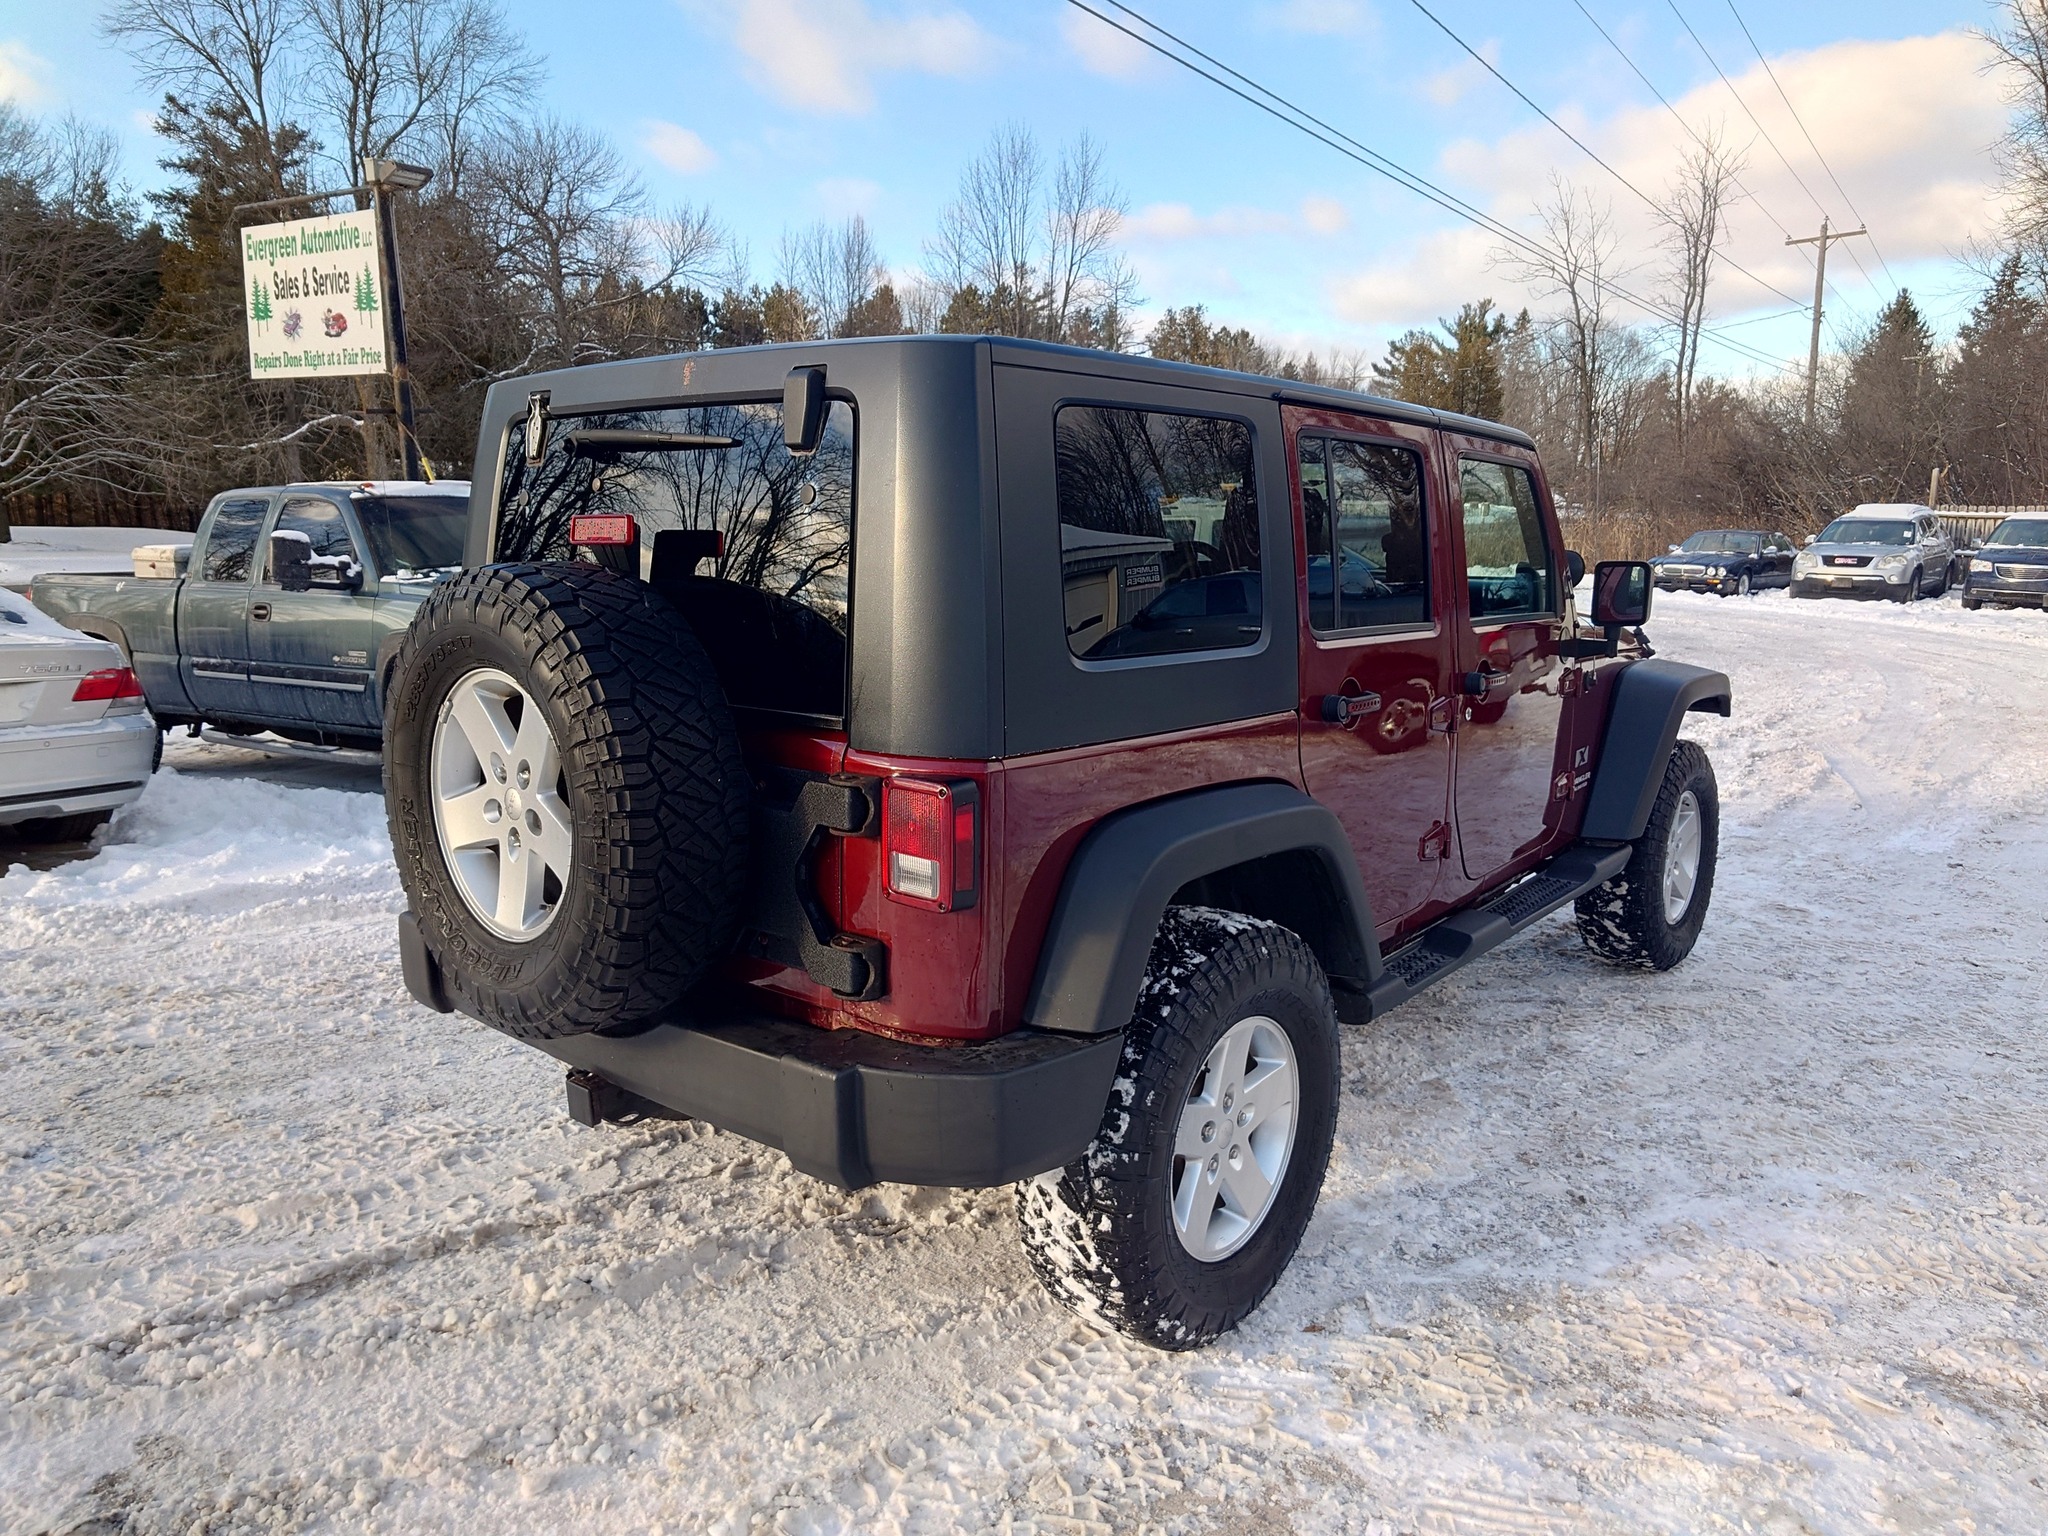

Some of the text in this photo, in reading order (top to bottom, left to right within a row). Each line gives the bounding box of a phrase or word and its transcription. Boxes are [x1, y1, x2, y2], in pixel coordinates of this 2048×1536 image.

[246, 220, 372, 266] Evergreen Automotive LLC
[273, 264, 350, 300] Sales & Service
[254, 347, 382, 372] Repairs Done Right at a Fair Price
[1575, 745, 1589, 768] X
